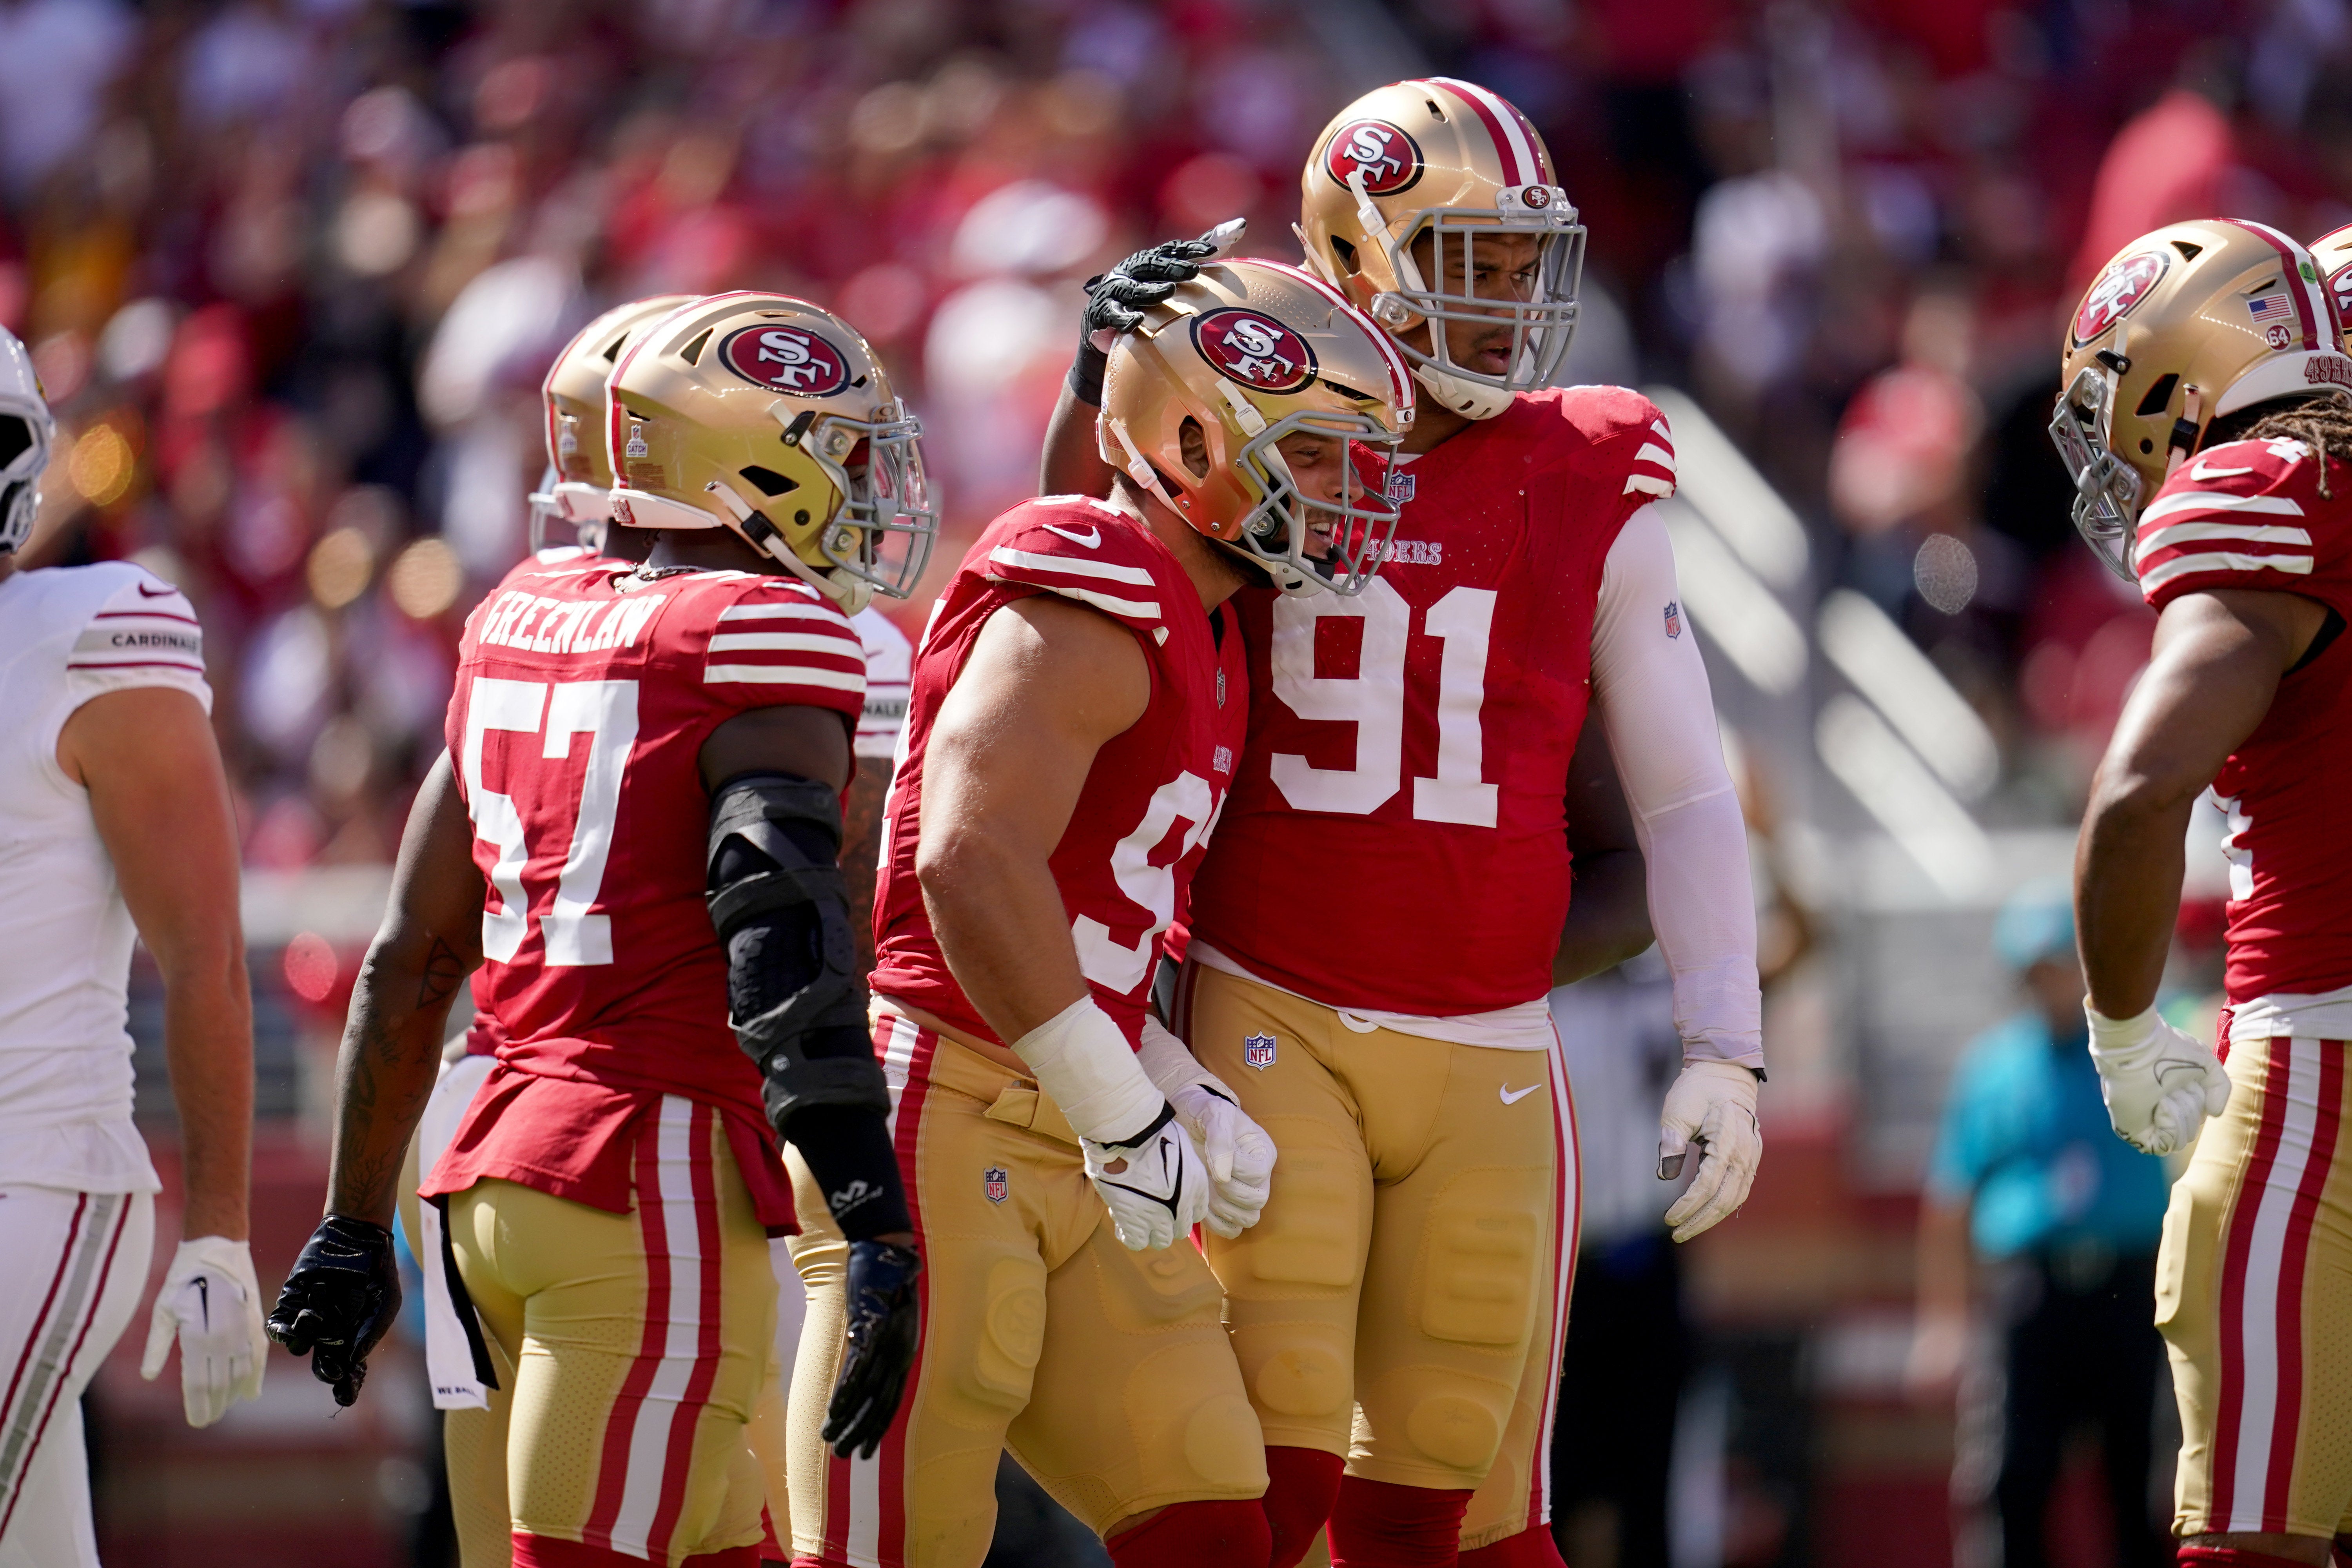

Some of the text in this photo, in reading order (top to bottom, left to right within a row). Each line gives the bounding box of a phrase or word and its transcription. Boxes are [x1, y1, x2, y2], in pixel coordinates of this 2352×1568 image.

[1343, 126, 1402, 187] SF
[2088, 264, 2148, 325] SF
[758, 331, 831, 388] SF
[1222, 319, 1294, 380] SF
[2267, 328, 2289, 346] 64
[1388, 485, 1410, 499] NFL
[1365, 539, 1442, 566] 49ERS
[479, 591, 667, 654] GREENLAW
[1666, 616, 1680, 635] NFL
[1270, 573, 1499, 829] 91
[463, 677, 640, 966] 57
[1249, 1049, 1271, 1063] NFL
[988, 1183, 1005, 1198] NFL
